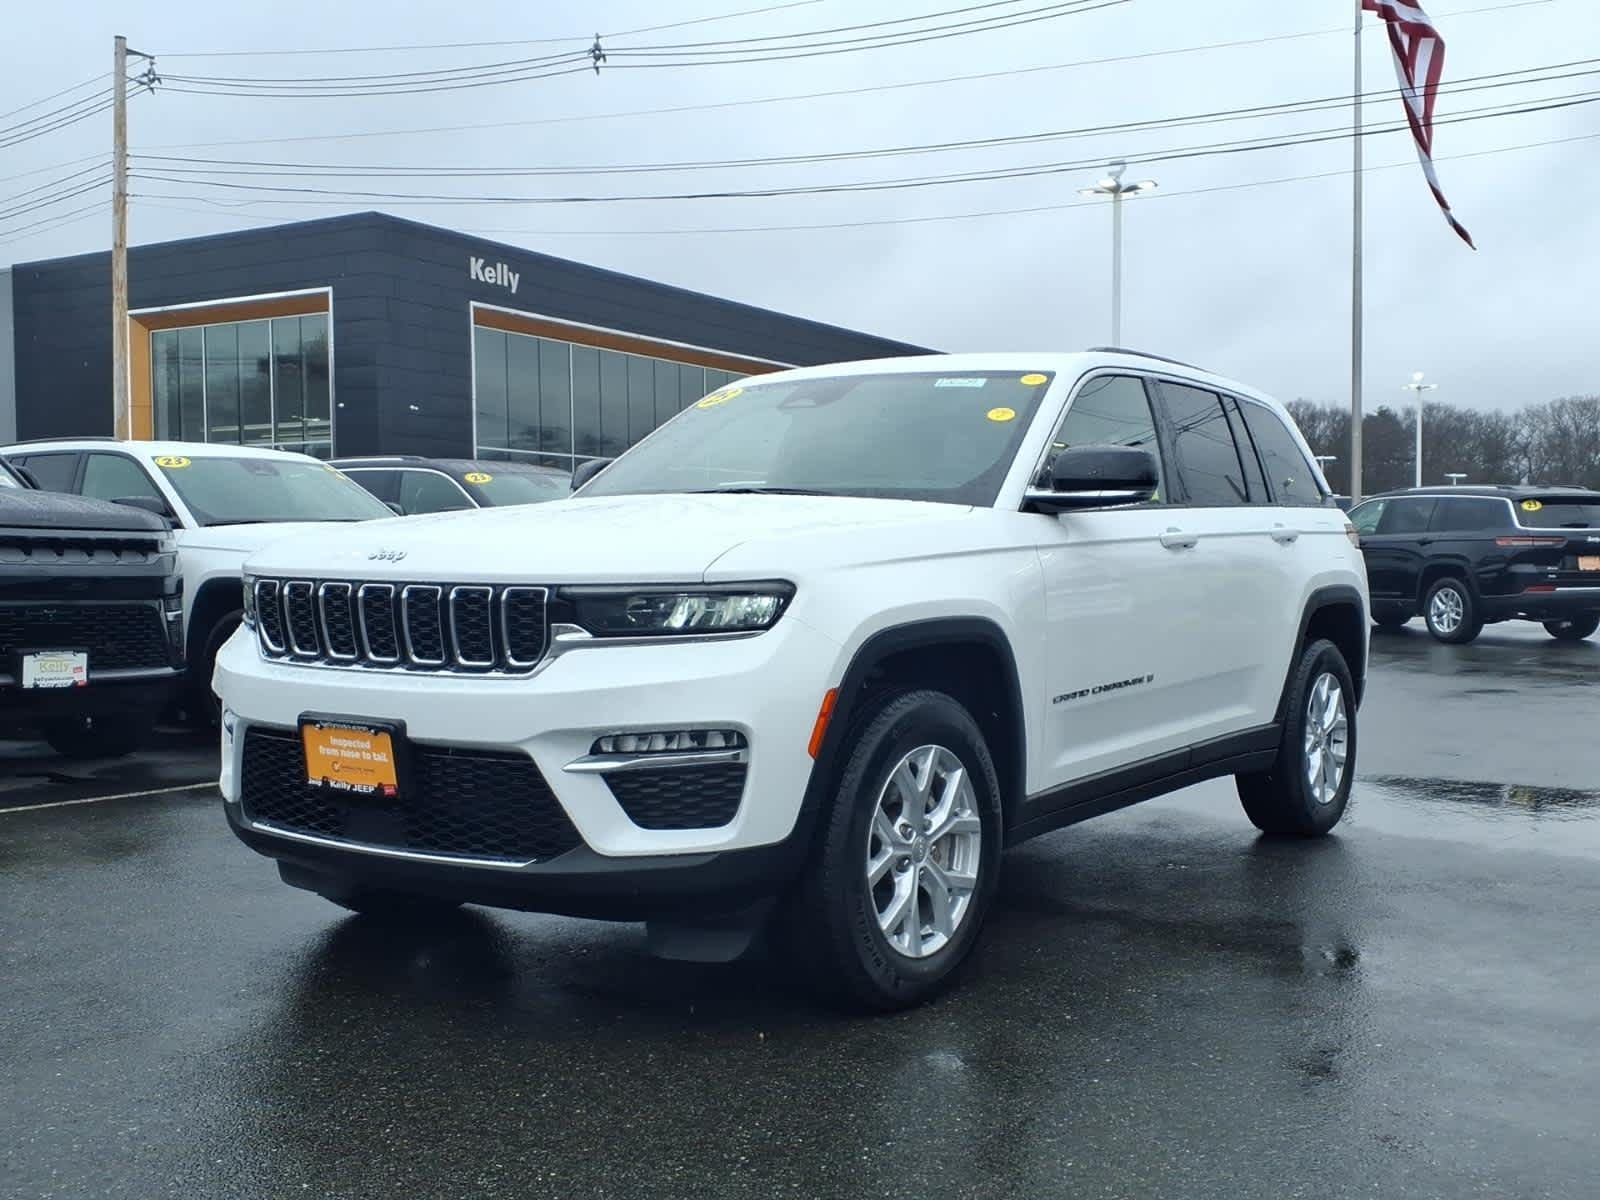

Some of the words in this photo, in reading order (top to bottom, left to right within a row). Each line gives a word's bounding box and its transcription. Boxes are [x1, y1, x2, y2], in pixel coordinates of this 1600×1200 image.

[470, 256, 519, 294] Kelly
[162, 457, 184, 466] 23
[368, 549, 408, 565] Jeep
[40, 661, 70, 673] Kelly
[330, 736, 371, 749] Inspected
[320, 745, 339, 756] from
[340, 750, 361, 760] nose
[362, 751, 371, 759] to
[330, 781, 351, 791] Kelly
[352, 784, 375, 792] JEEP
